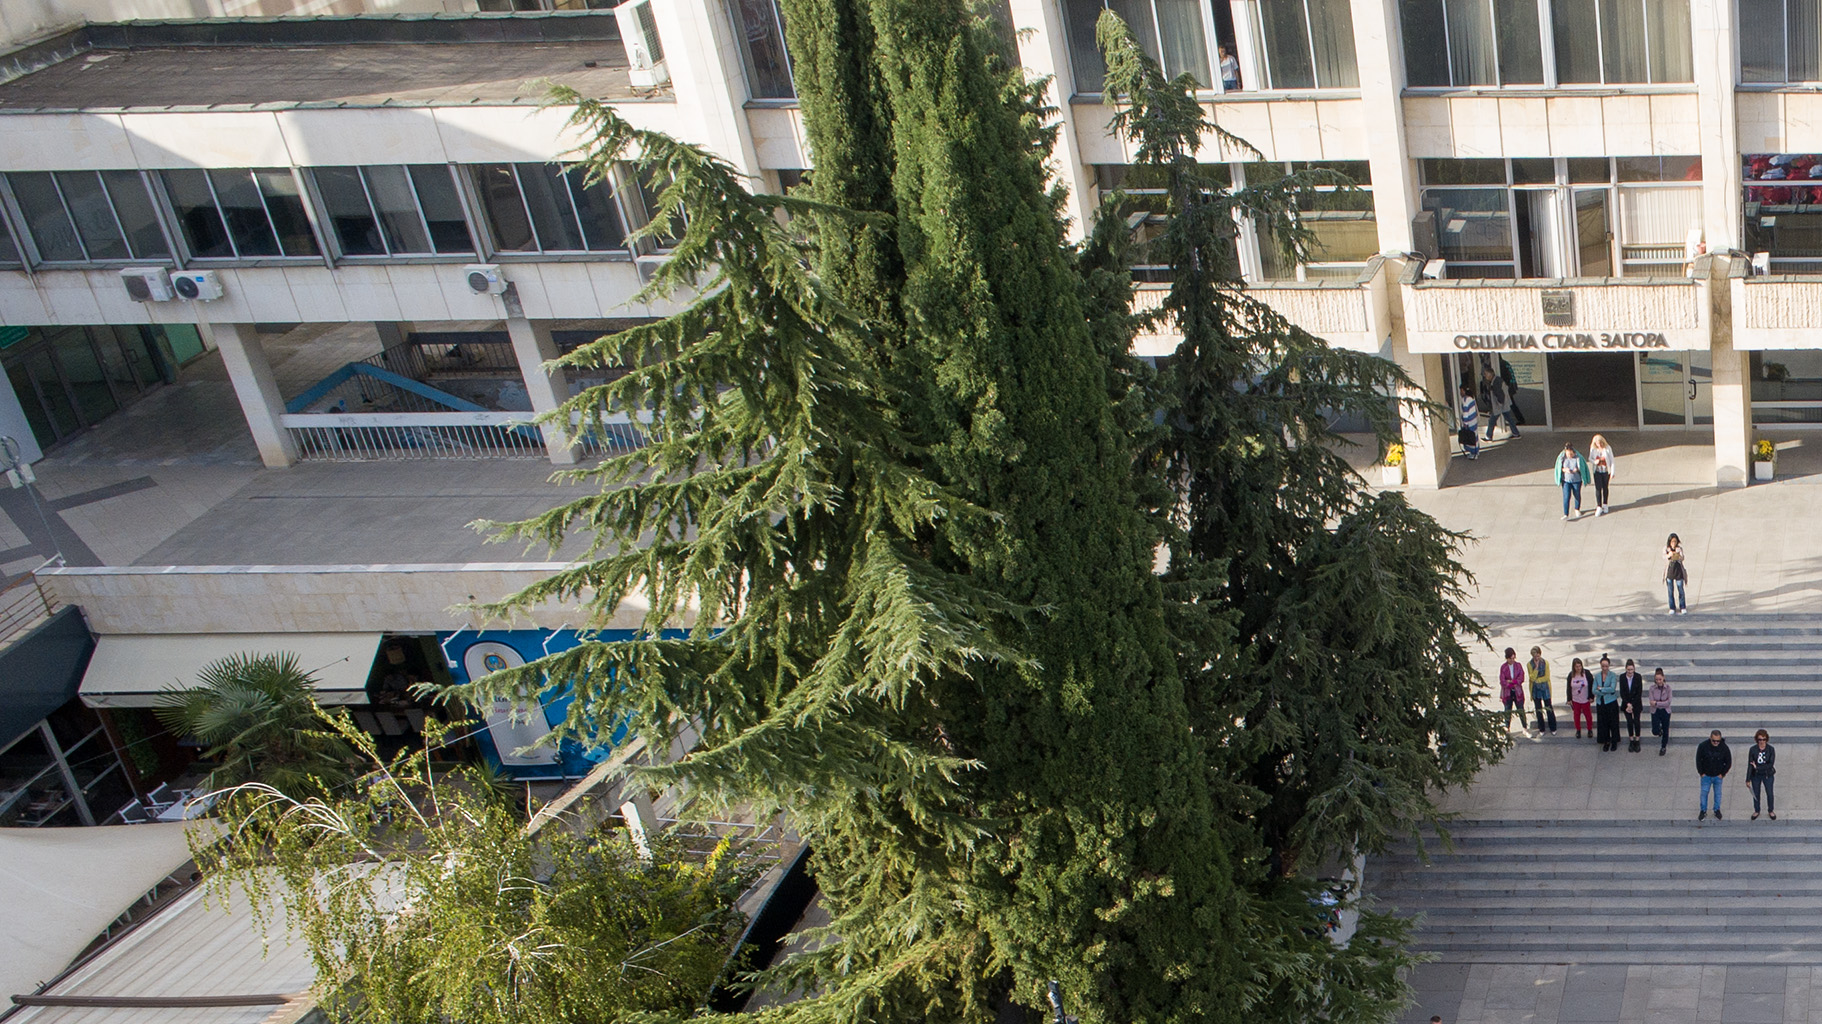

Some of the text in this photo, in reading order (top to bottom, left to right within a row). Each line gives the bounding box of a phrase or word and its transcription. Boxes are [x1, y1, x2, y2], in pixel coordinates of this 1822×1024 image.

[1453, 332, 1670, 350] ОБЩИНА СТАРА ЗАГОРА
